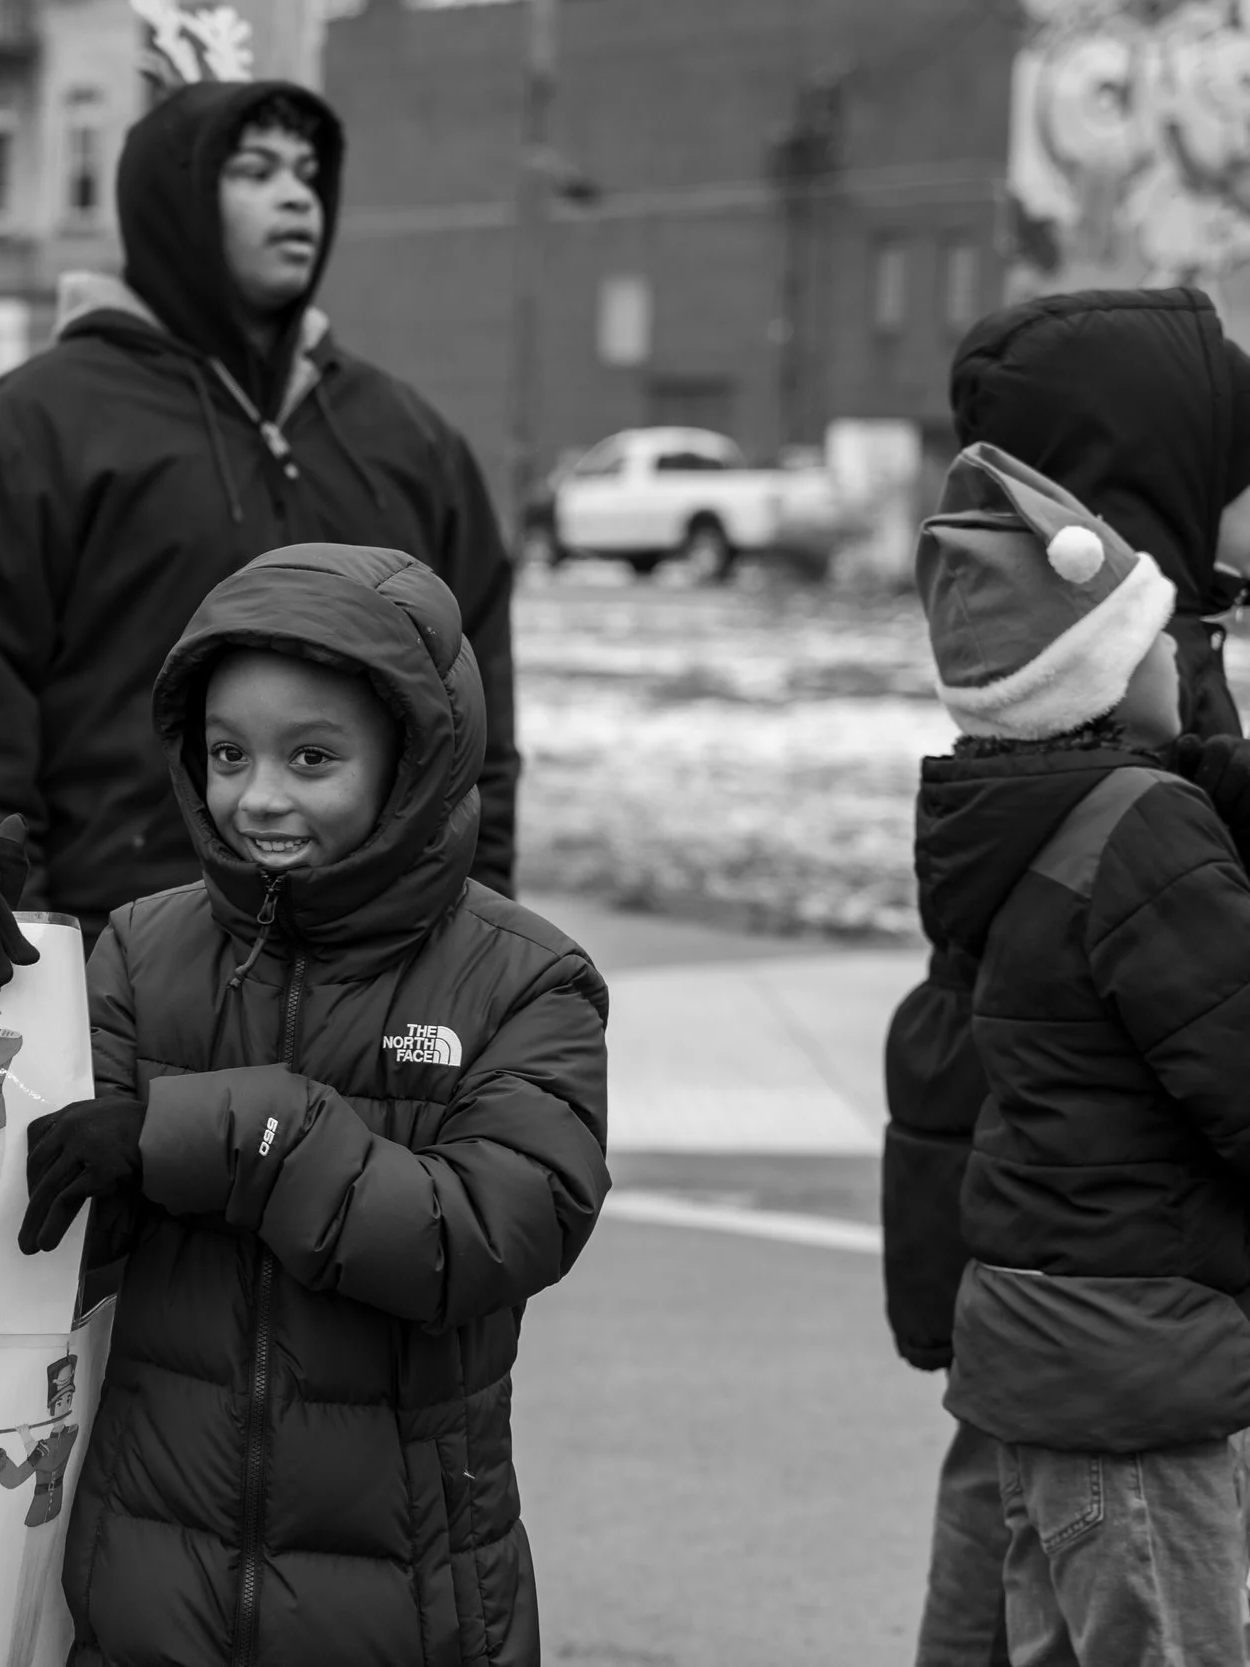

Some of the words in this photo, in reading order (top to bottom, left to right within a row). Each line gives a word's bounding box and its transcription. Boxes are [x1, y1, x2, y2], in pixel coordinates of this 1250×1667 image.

[407, 1024, 437, 1038] THE
[383, 1036, 435, 1050] NORTH
[396, 1049, 433, 1063] FACE
